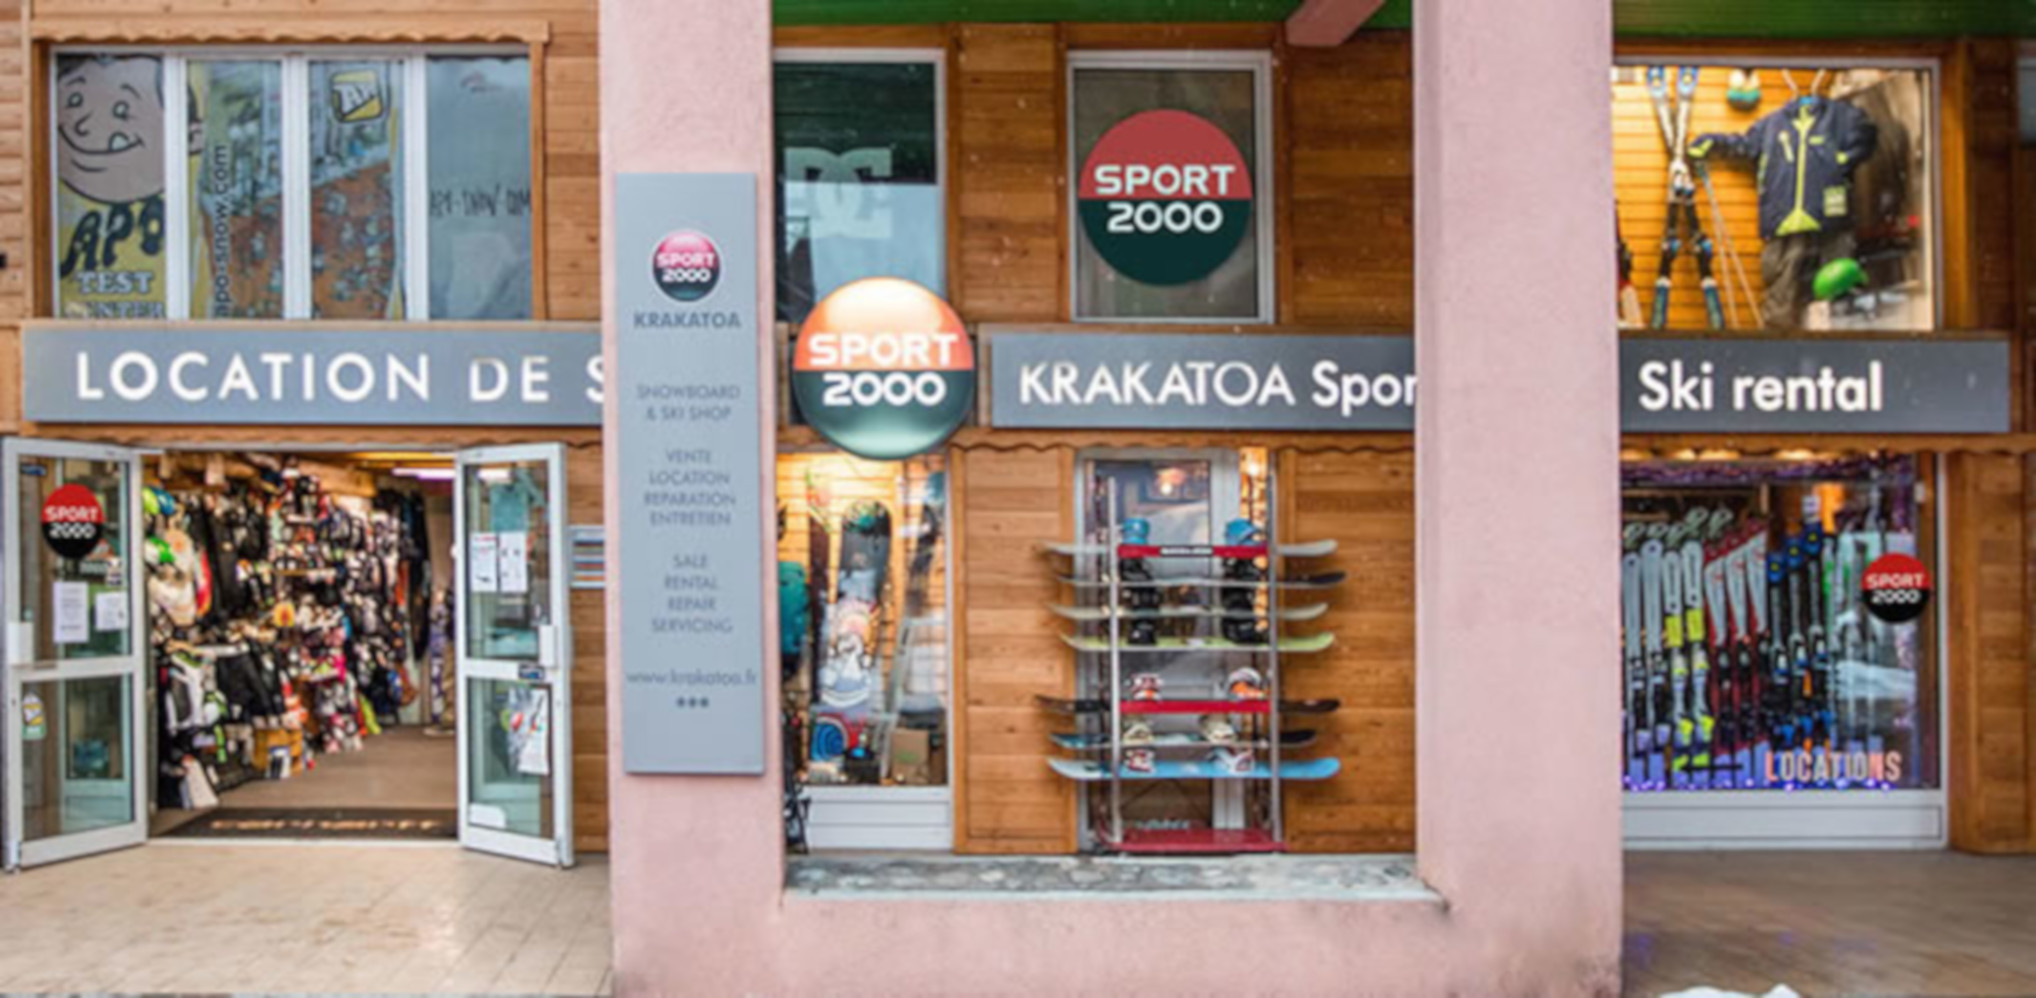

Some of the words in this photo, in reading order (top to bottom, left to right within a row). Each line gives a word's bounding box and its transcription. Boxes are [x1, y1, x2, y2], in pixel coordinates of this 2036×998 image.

[1094, 163, 1237, 196] SPORT
[1106, 201, 1224, 233] 2000
[656, 253, 716, 269] SPORT
[75, 271, 155, 294] TEST
[661, 268, 712, 283] 2000
[632, 311, 742, 329] KRAKATOA
[807, 332, 959, 367] SPORT
[77, 351, 430, 402] LOCATION
[469, 355, 549, 402] DE
[1019, 361, 1297, 406] KRAKATOA
[636, 384, 741, 400] SNOWBOARD
[821, 371, 947, 407] 2000
[1638, 359, 1714, 412] Ski
[1732, 360, 1883, 412] rental
[660, 406, 685, 420] SKI
[688, 405, 731, 420] SHOP
[665, 449, 711, 463] VENTE
[648, 470, 730, 485] LOCATION
[643, 491, 737, 506] REPARATION
[44, 506, 98, 522] SPORT
[649, 511, 732, 526] ENTRETIEN
[50, 522, 97, 539] 2000
[672, 554, 708, 568] SALE
[663, 574, 719, 590] RENTAL
[1865, 573, 1923, 589] SPORT
[667, 597, 717, 611] REPAIR
[1871, 589, 1921, 605] 2000
[651, 618, 734, 634] SERVICING
[627, 668, 757, 686] www.krakatoa.fr
[1765, 751, 1902, 782] LOCATIONS
